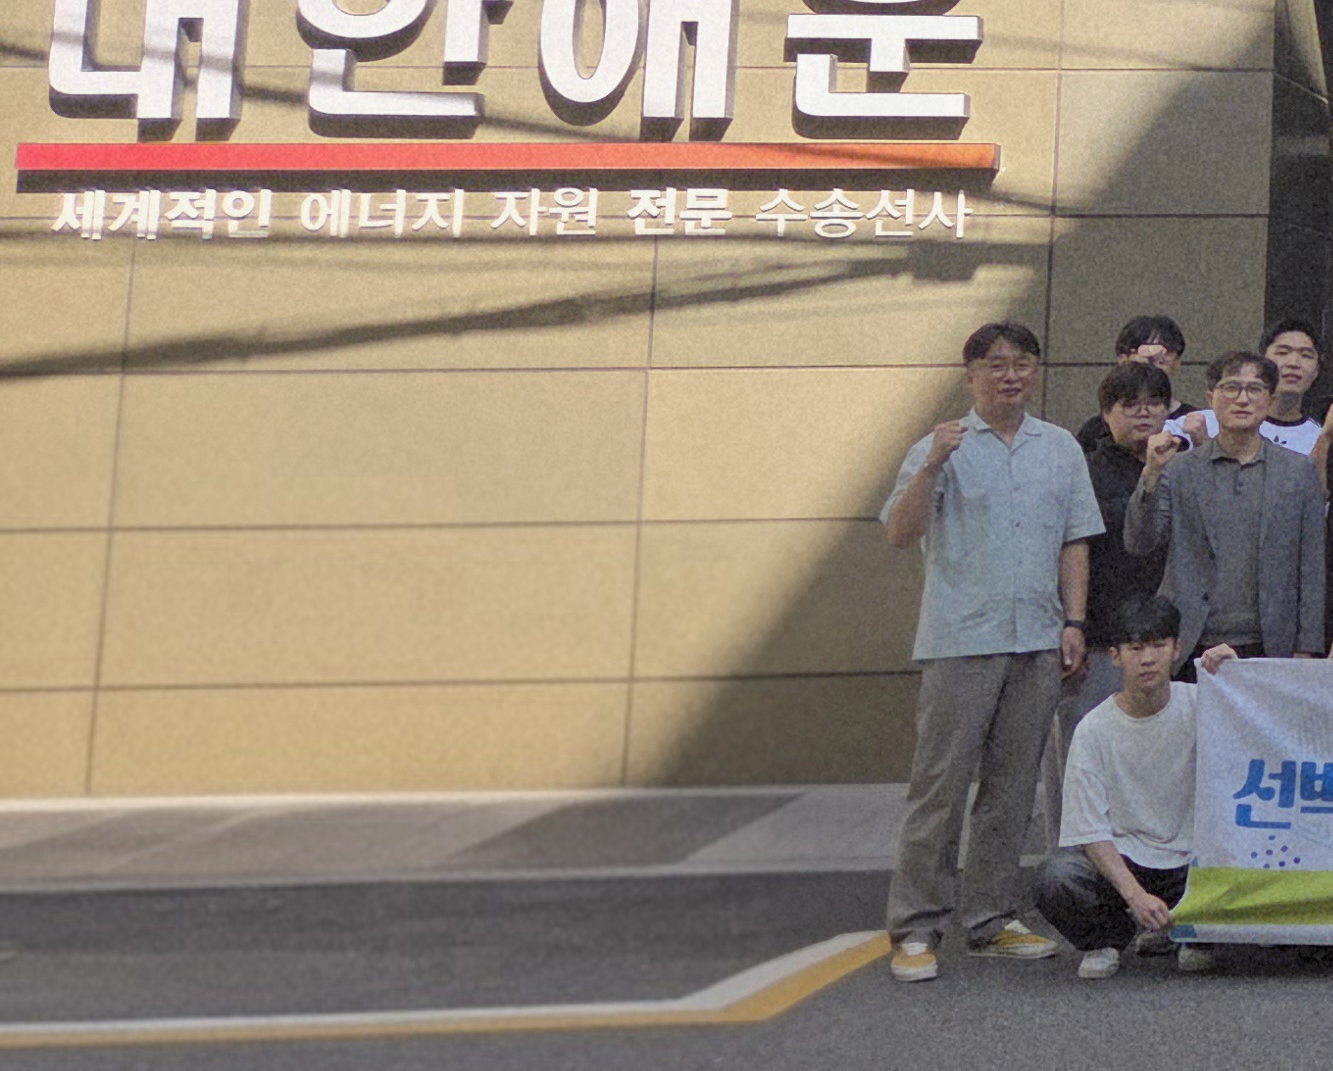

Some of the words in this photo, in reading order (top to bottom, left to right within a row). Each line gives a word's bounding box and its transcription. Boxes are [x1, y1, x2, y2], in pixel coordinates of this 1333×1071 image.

[50, 188, 274, 241] 세계적인
[300, 188, 464, 237] 에너지
[489, 187, 600, 235] 자원
[626, 187, 733, 235] 전문
[755, 187, 974, 237] 수송선사
